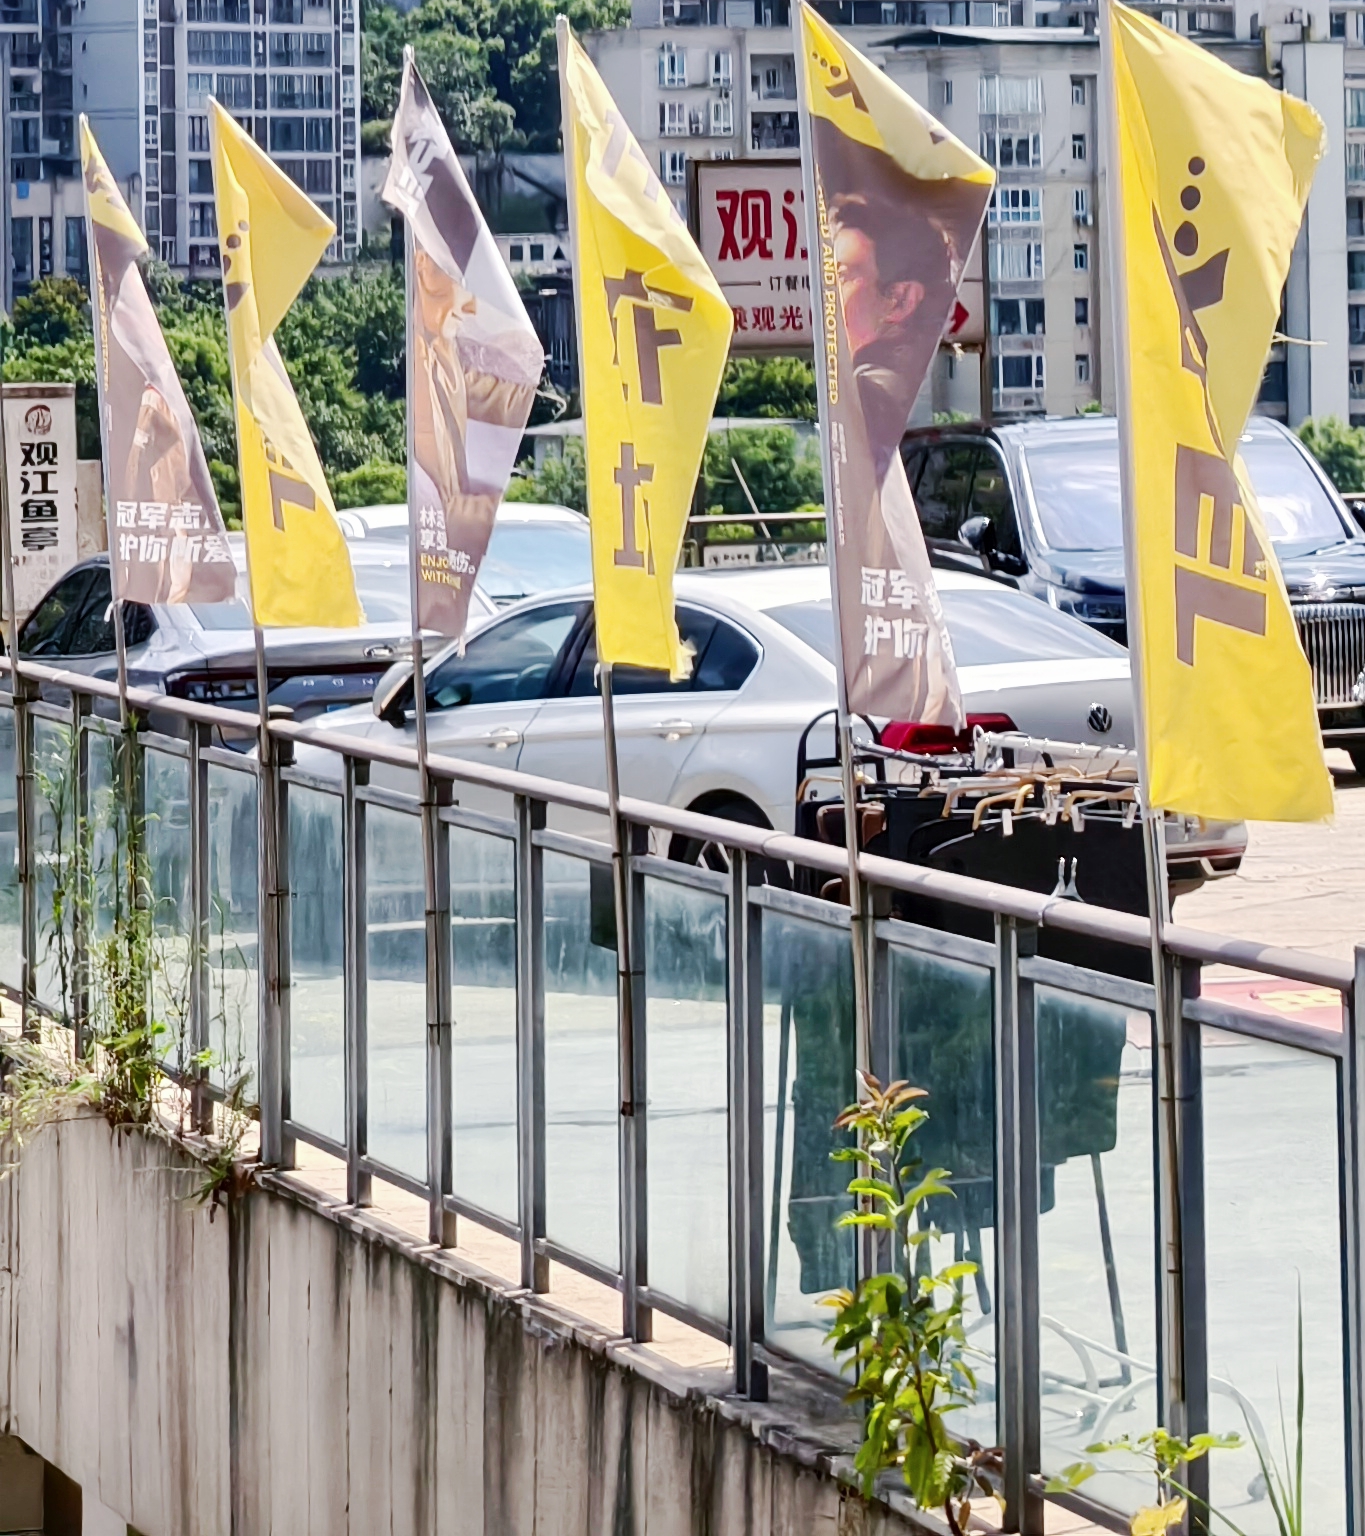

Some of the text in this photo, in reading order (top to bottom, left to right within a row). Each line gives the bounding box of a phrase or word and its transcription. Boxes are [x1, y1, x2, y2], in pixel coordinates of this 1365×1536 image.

[734, 305, 812, 332] 观光
[823, 290, 839, 405] PROTECTED
[116, 501, 212, 531] 冠军志
[864, 615, 930, 659] 护你
